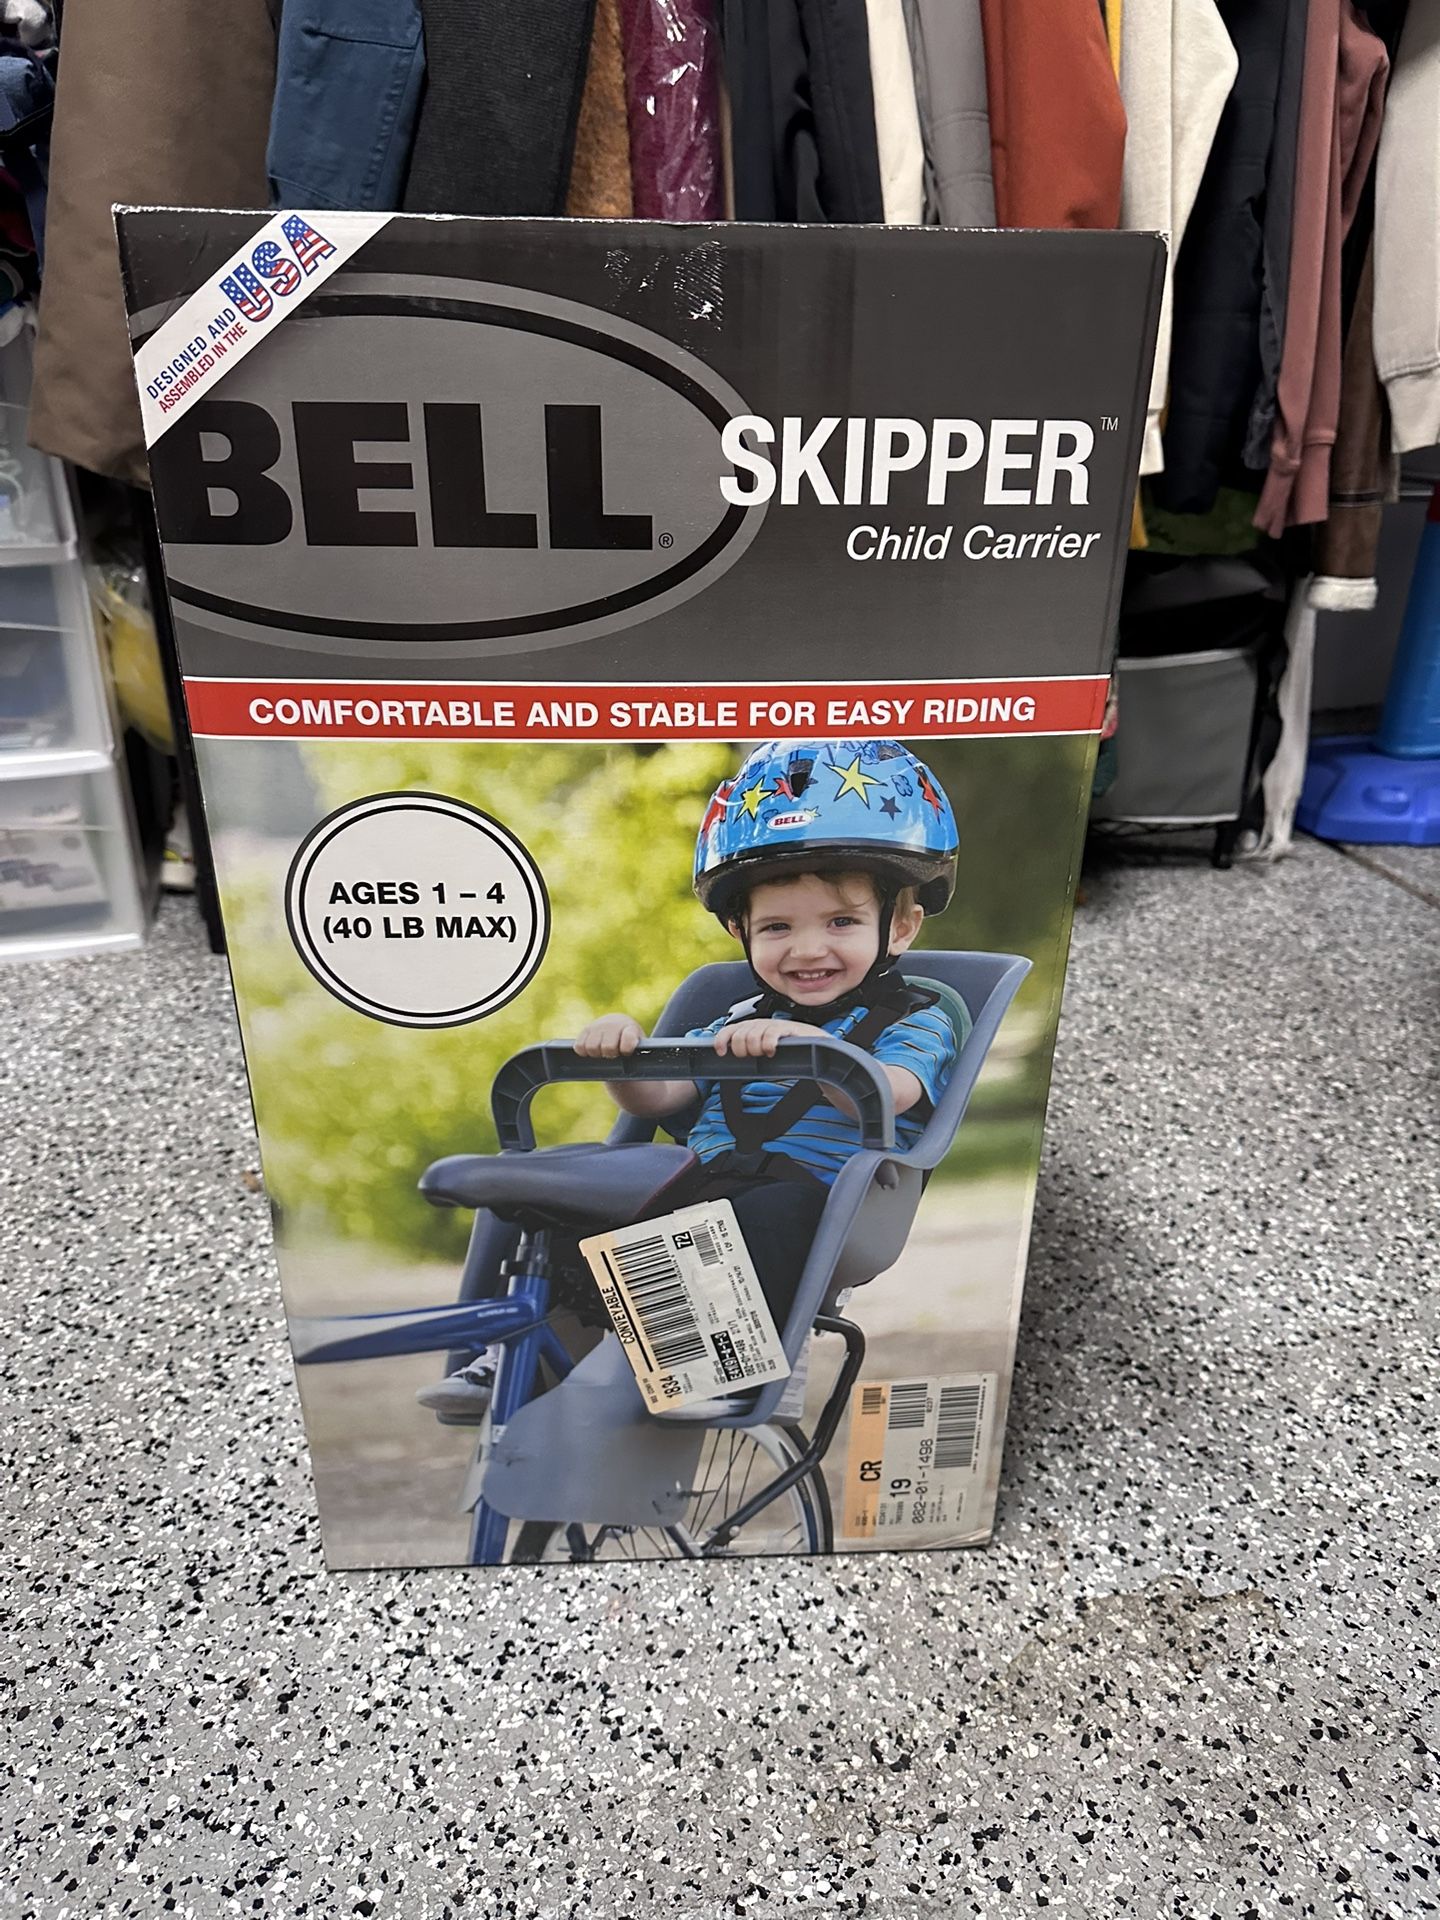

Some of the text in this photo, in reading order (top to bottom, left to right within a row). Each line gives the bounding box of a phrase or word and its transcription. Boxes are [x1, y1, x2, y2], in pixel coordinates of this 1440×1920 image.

[219, 214, 338, 323] USA
[146, 307, 236, 400] DESIGNED AND
[158, 322, 248, 413] ASSEMBLED IN THE
[148, 400, 653, 550] BELL
[719, 414, 1096, 507] SKIPPER
[846, 525, 1101, 560] Child Carrier
[248, 696, 1036, 727] COMFORTABLE AND STABLE FOR EASY RIDING
[774, 815, 806, 826] BELL
[329, 881, 420, 904] AGES
[432, 882, 446, 904] 1
[486, 882, 505, 904] 4
[323, 916, 517, 943] (40 LB MAX)
[675, 1232, 690, 1247] 72
[602, 1286, 635, 1344] CONVEYABLE
[659, 1374, 682, 1398] 1834
[859, 1460, 882, 1482] CR
[911, 1438, 934, 1524] 082-01-1498
[889, 1478, 911, 1498] 19
